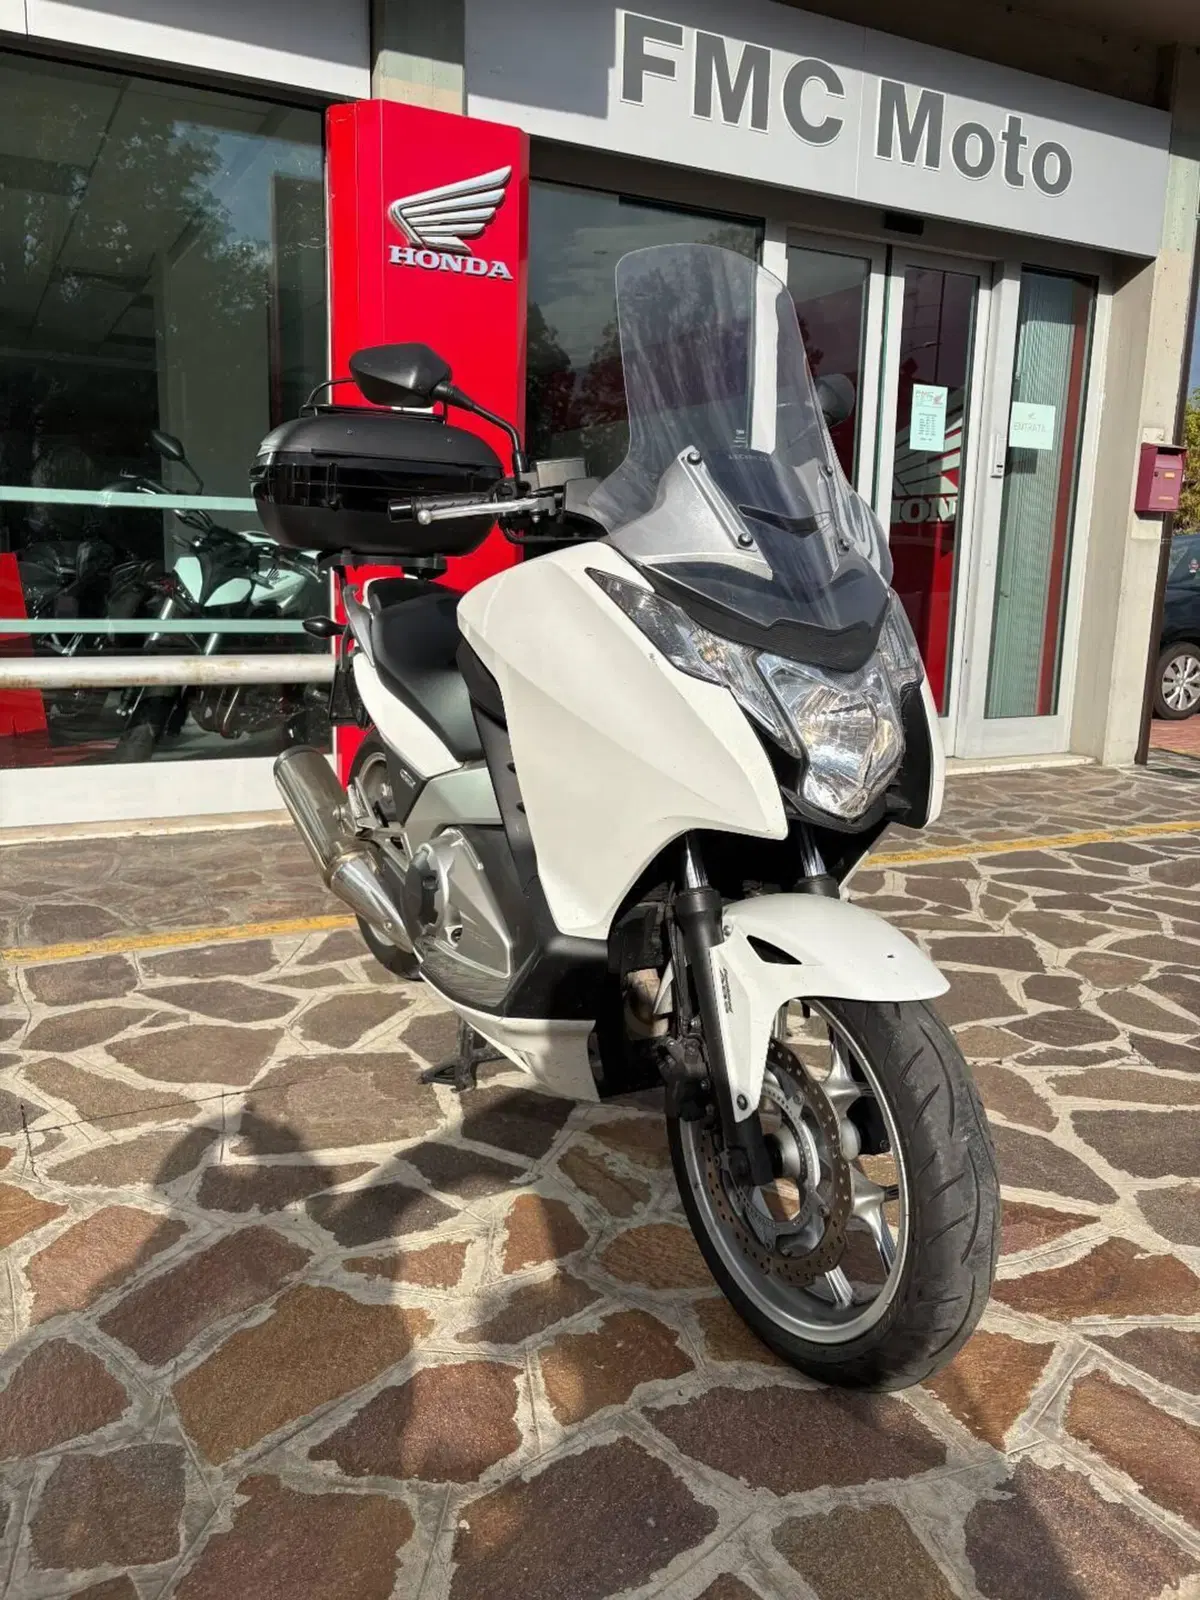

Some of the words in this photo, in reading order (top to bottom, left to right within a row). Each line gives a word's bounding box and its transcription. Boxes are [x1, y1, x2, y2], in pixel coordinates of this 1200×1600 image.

[619, 9, 846, 147] FMC
[874, 76, 1073, 197] Moto
[388, 245, 514, 281] HONDA
